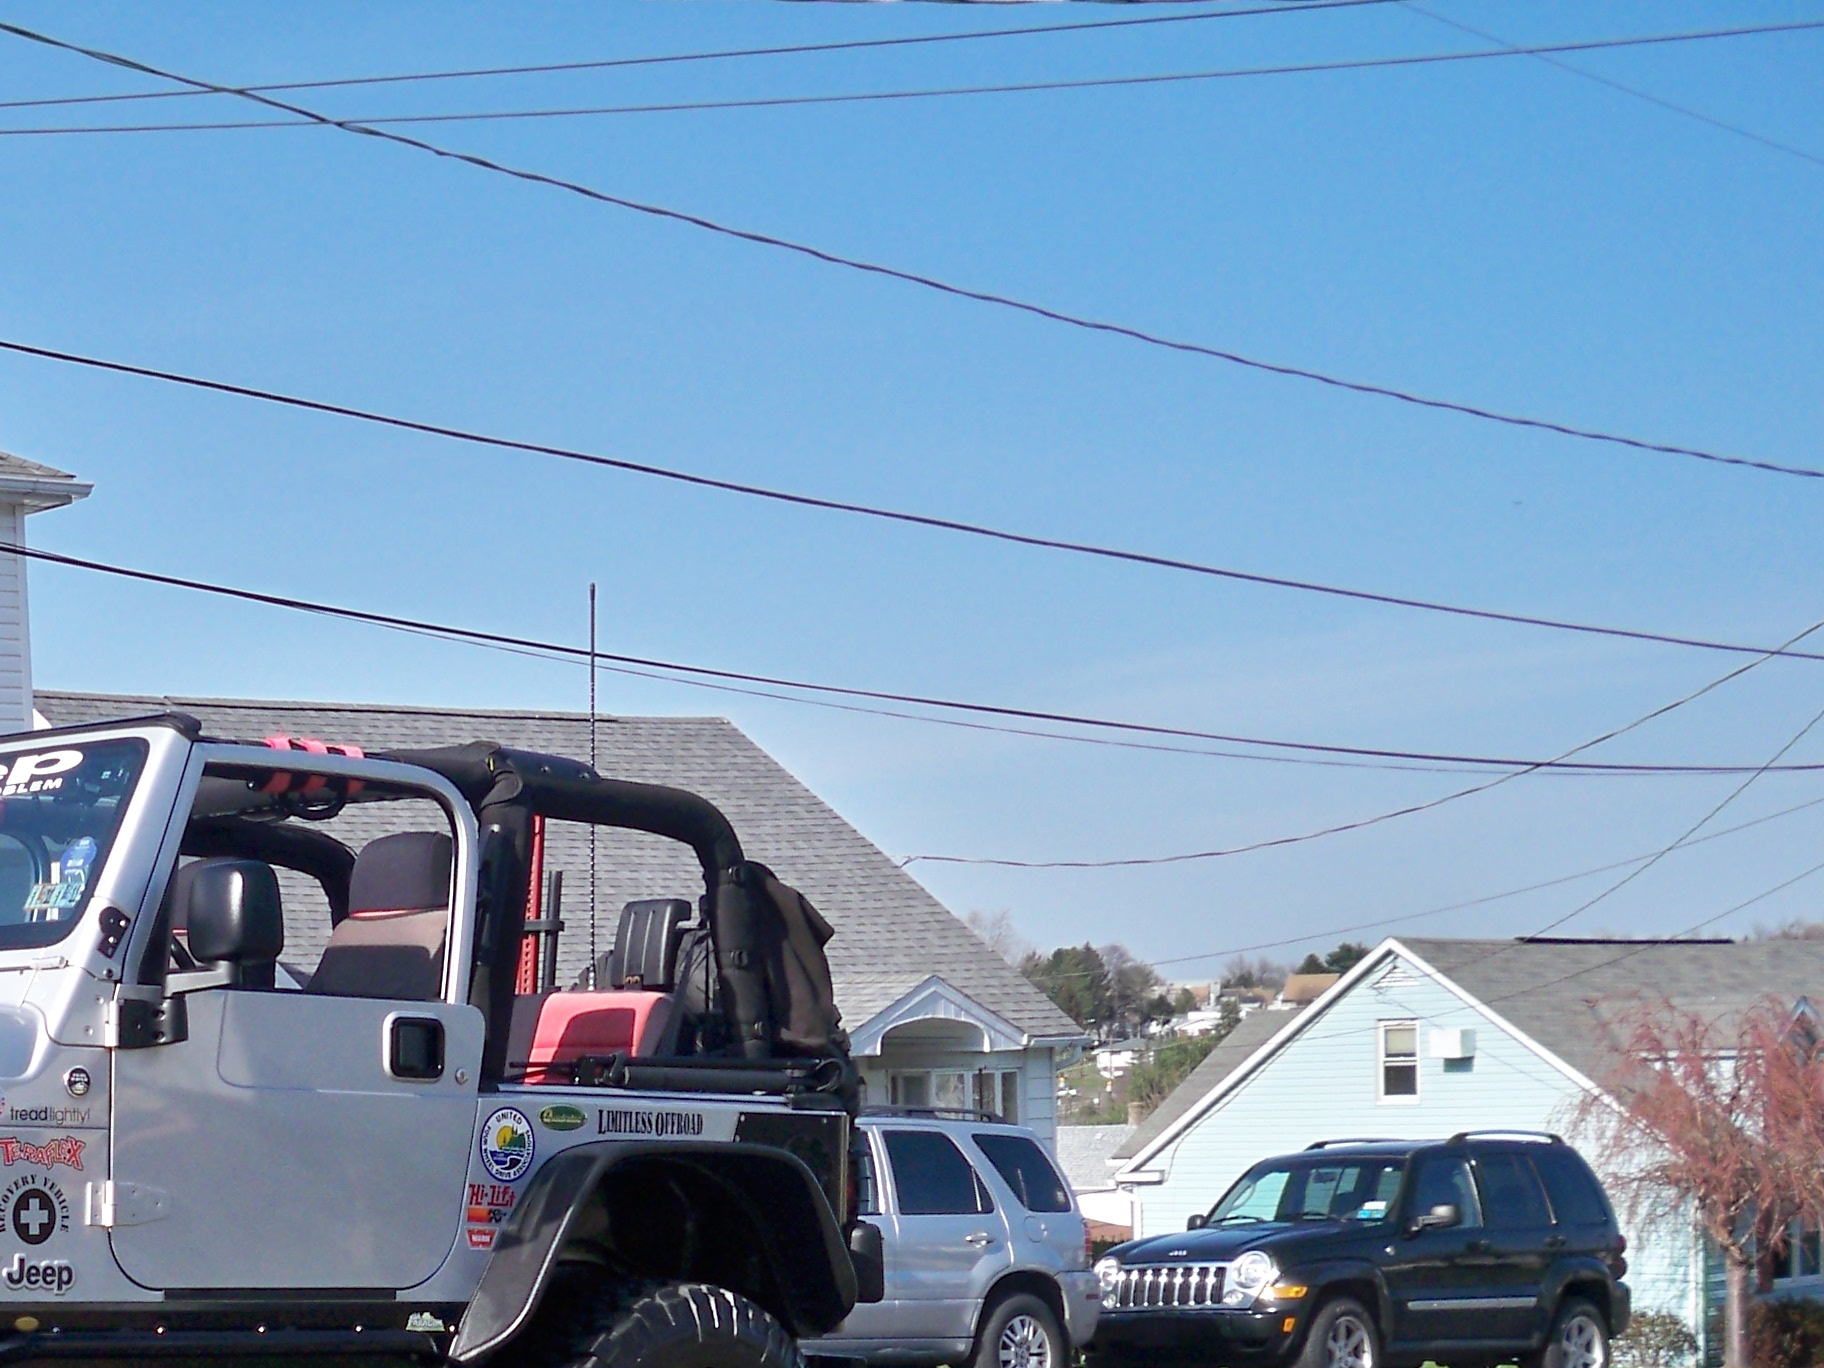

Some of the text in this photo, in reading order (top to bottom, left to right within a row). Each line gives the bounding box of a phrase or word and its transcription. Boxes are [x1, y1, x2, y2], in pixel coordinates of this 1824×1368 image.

[494, 1111, 523, 1126] UNITED
[597, 1109, 653, 1135] LIMITLESS
[655, 1112, 704, 1136] OFFROAD
[42, 1176, 71, 1233] VEHICLE
[5, 1254, 75, 1293] Jeep
